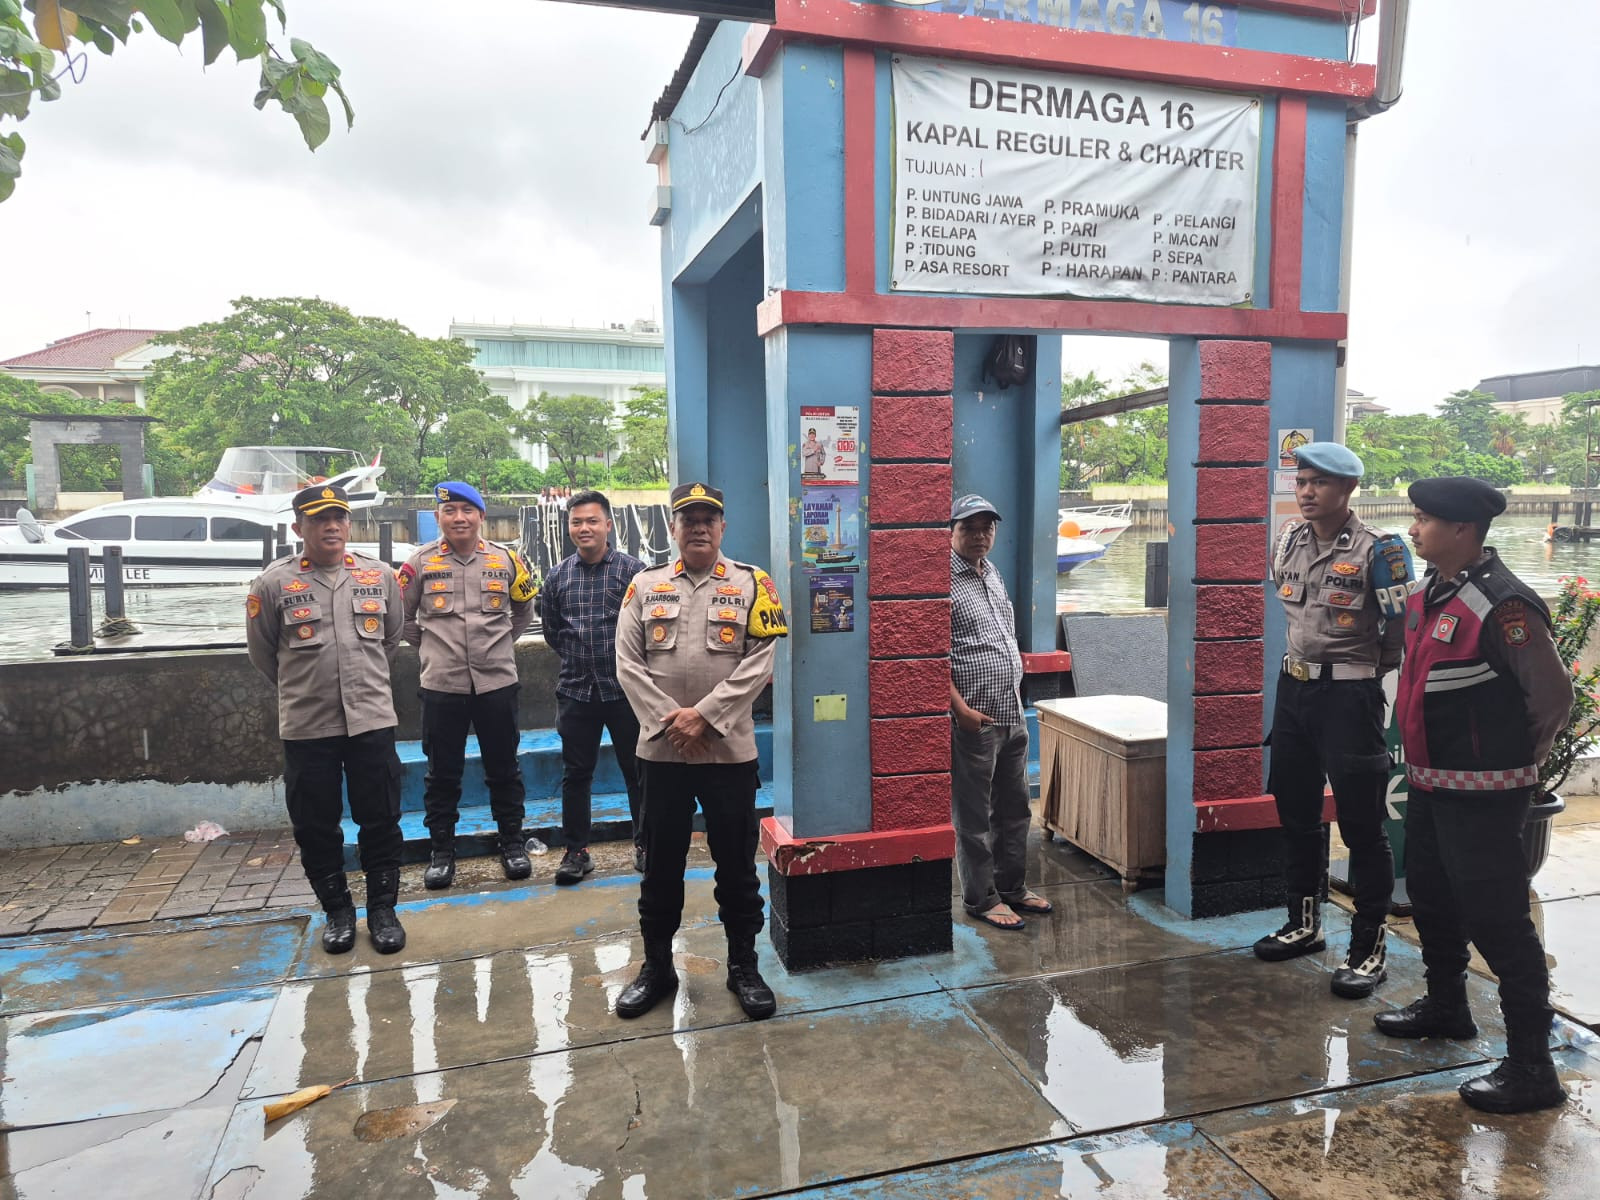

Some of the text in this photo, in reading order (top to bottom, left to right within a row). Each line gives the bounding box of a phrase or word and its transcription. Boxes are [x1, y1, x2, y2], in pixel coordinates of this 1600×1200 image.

[1183, 2, 1225, 46] 16
[969, 77, 1195, 131] DERMAGA 16
[906, 120, 1244, 171] KAPAL REGULER & CHARTER
[905, 158, 966, 177] TUJUAN
[907, 188, 1023, 209] P. UNTUNG JAWA
[906, 205, 918, 219] P.
[922, 207, 989, 224] BIDADARI
[999, 212, 1036, 227] AYER
[1044, 199, 1140, 220] P. PRAMUKA
[1043, 220, 1098, 238] P. PARI
[1174, 213, 1236, 230] PELANGI
[906, 223, 977, 241] P. KELAPA
[1153, 231, 1219, 248] P. MACAN
[1043, 240, 1106, 259] P. PUTRI
[1152, 249, 1203, 265] P. SEPA
[905, 259, 1010, 277] P. ASA RESORT
[1042, 261, 1052, 276] P
[1066, 262, 1143, 281] HARAPAN
[1151, 267, 1161, 281] P
[1172, 269, 1238, 285] PANTARA
[837, 440, 855, 453] 110
[804, 502, 834, 511] LAYANAN
[126, 568, 150, 580] LEE
[482, 571, 509, 580] POLRI
[1325, 574, 1364, 589] POLRI
[284, 593, 316, 606] SURYA
[352, 587, 383, 596] POLRI
[711, 596, 746, 607] POLRI
